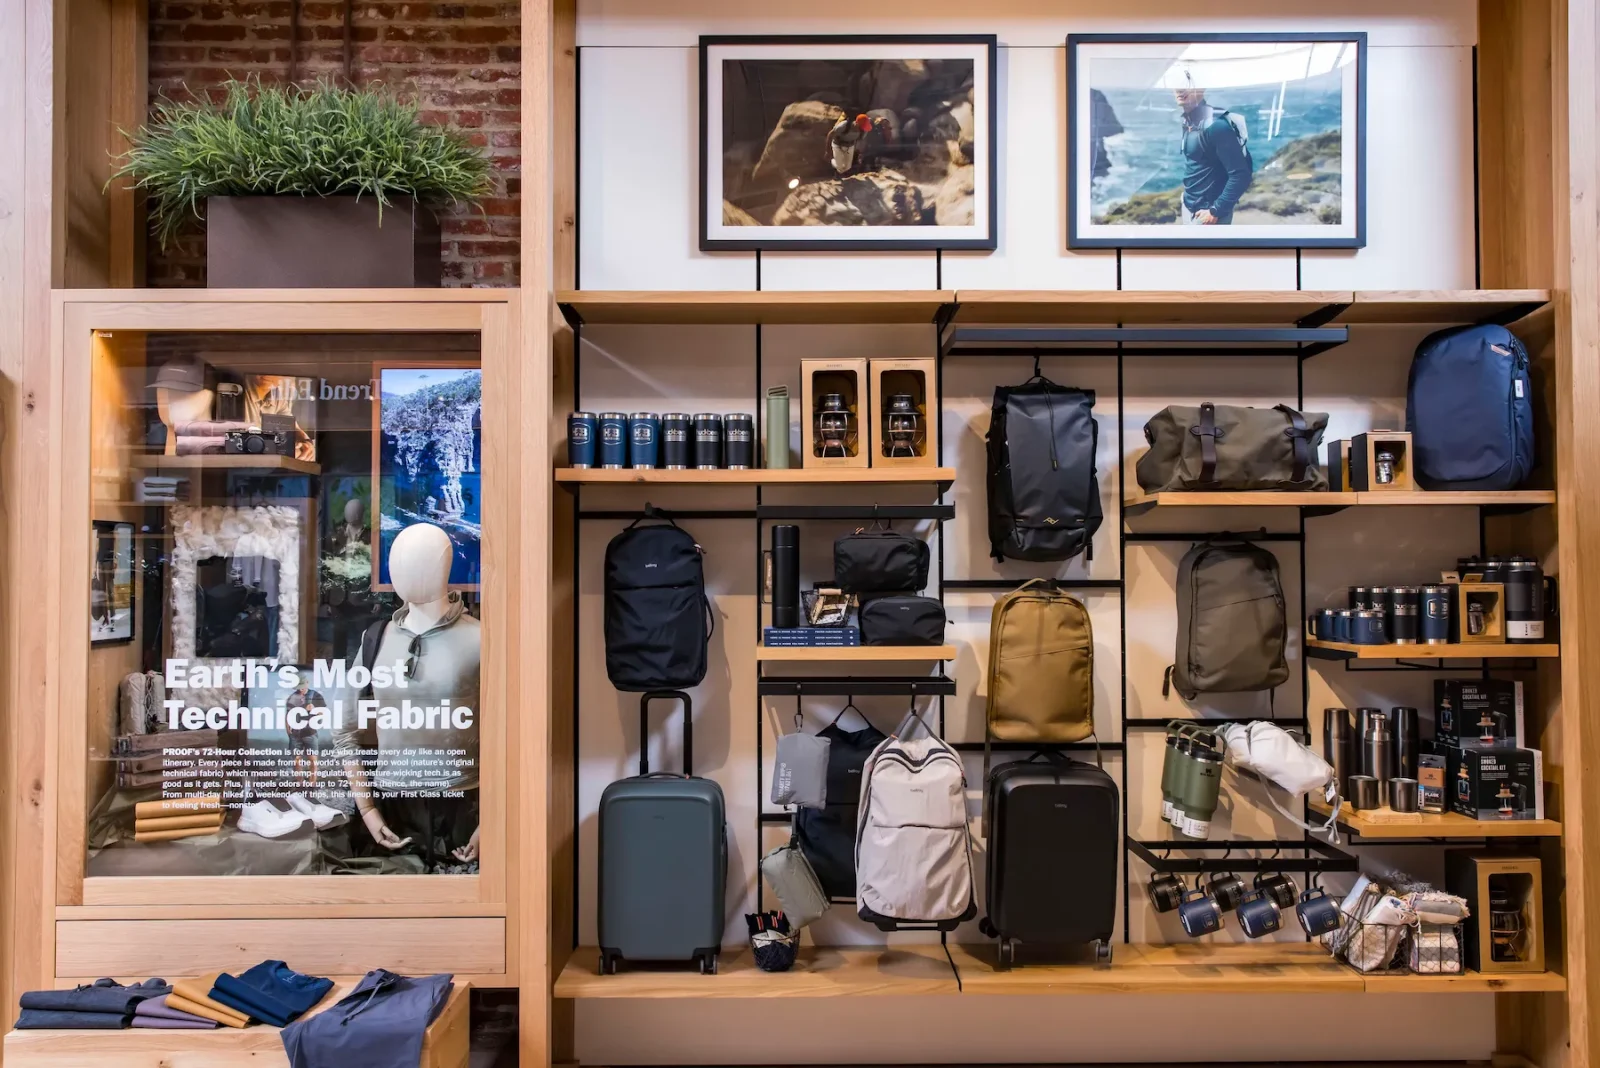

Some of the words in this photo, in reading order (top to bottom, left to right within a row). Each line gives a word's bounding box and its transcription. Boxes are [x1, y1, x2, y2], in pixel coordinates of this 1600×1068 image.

[165, 658, 299, 689] Earth's
[313, 658, 409, 689] Most
[163, 699, 343, 730] Technical
[358, 699, 474, 730] Fabric
[163, 748, 200, 756] PROOF's
[203, 748, 236, 756] 72-Hour
[238, 748, 282, 756] Collection
[284, 748, 290, 756] is
[293, 748, 304, 756] for
[307, 748, 318, 756] the
[337, 748, 353, 756] who
[356, 748, 378, 756] treats
[403, 748, 416, 757] day
[418, 748, 432, 756] like
[163, 759, 195, 767] itinerary.
[198, 759, 219, 767] Every
[221, 759, 242, 767] piece
[411, 759, 443, 767] (nature's
[446, 759, 474, 767] original
[199, 770, 224, 778] fabric)
[291, 770, 354, 778] temp-regulating,
[357, 770, 422, 778] moisture-wicking
[163, 780, 181, 789] good
[203, 780, 222, 789] gets.
[253, 780, 276, 789] repels
[379, 780, 407, 789] (hence,
[425, 780, 451, 789] name).
[185, 791, 220, 799] multi-day
[309, 791, 328, 799] trips,
[347, 791, 371, 799] lineup
[172, 802, 198, 810] feeling
